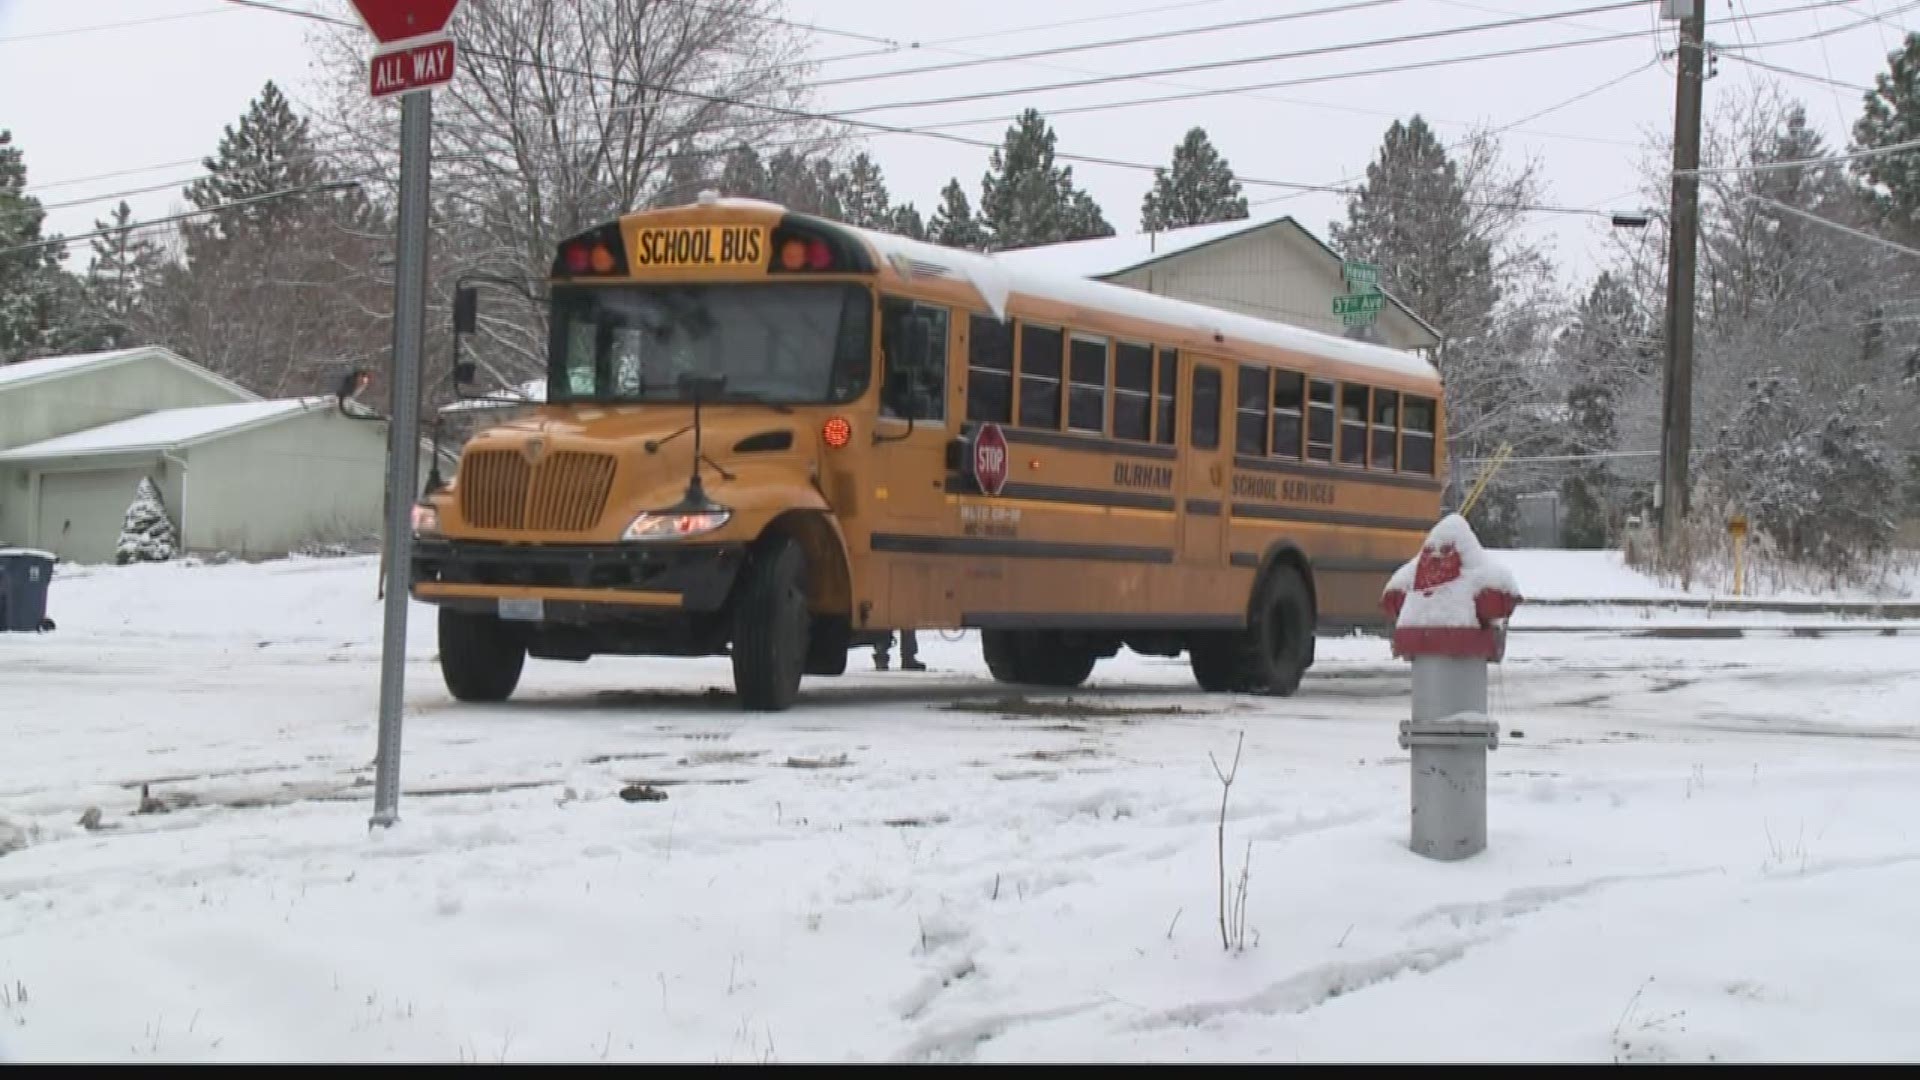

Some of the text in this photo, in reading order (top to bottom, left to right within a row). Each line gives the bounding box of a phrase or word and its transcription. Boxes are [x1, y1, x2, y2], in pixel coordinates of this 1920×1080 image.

[376, 47, 448, 89] ALL WAY
[640, 228, 761, 264] SCHOOL BUS
[979, 446, 1004, 474] STOP
[1114, 462, 1335, 504] DURHAM SCHOOL SERVICES
